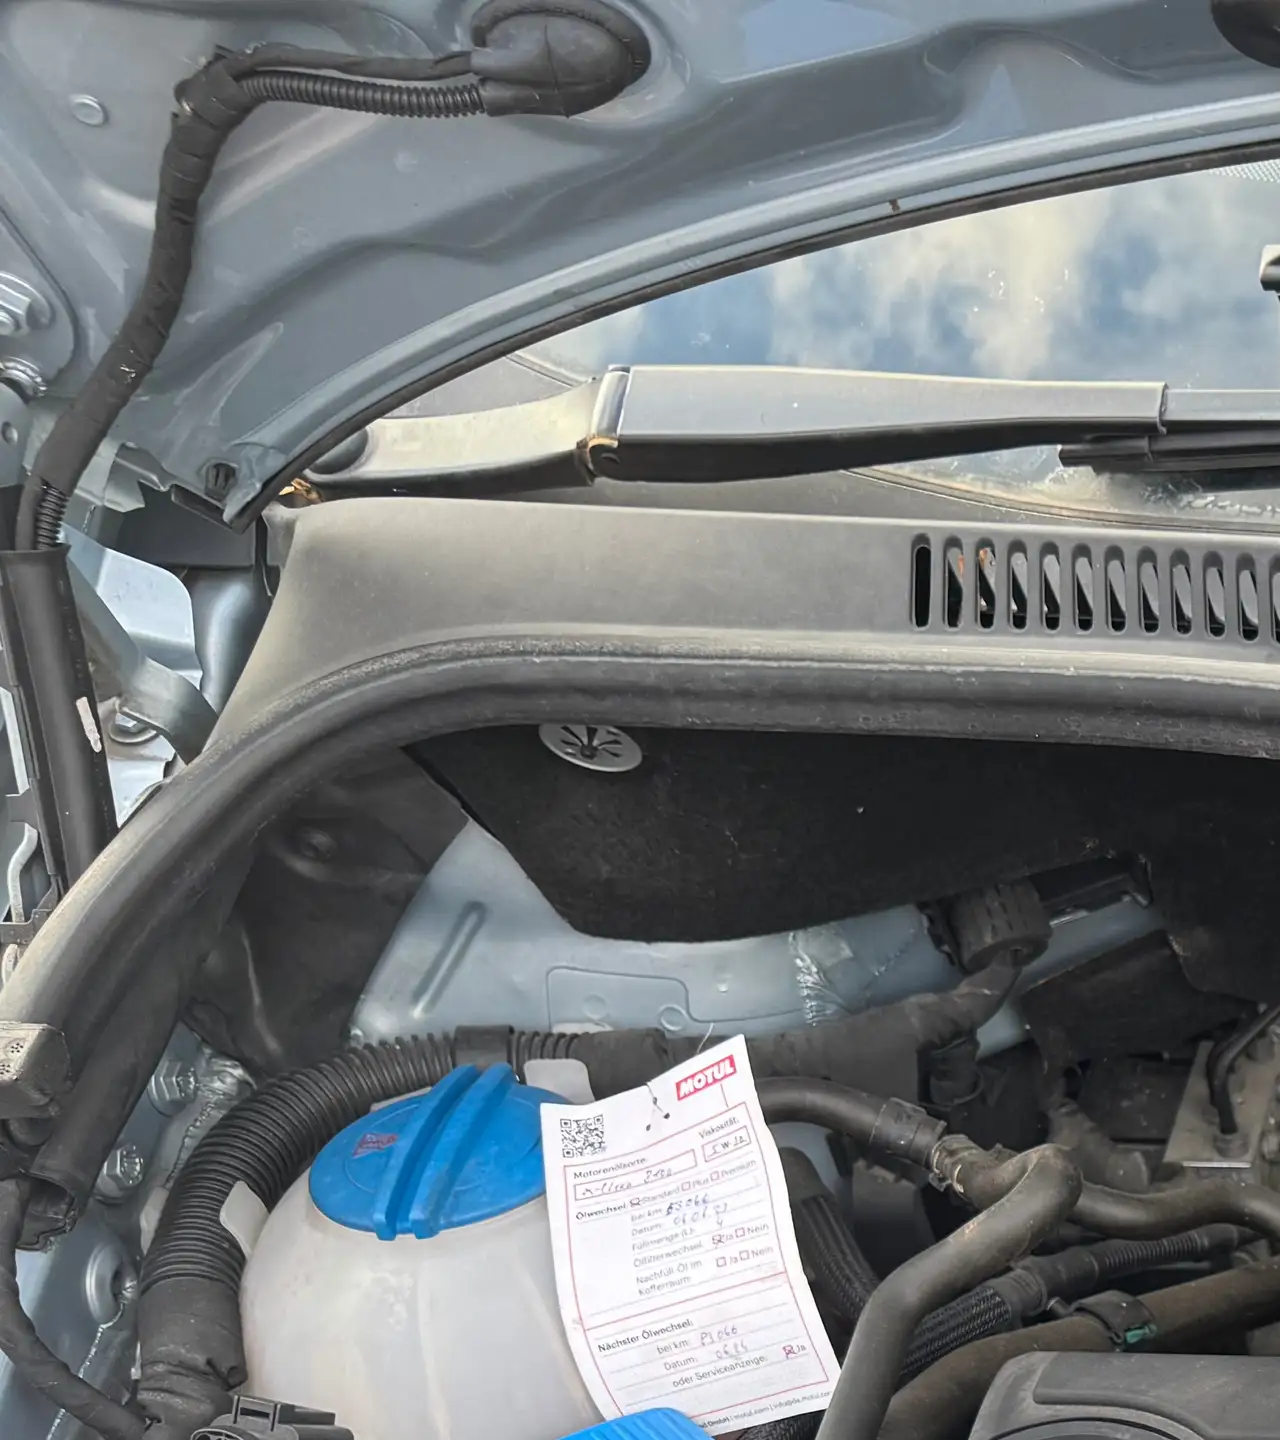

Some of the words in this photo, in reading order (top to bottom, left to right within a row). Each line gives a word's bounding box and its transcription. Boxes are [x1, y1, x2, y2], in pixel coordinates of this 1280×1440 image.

[677, 1058, 735, 1100] MOTUL
[597, 1335, 640, 1353] Nächster
[664, 1355, 698, 1372] Datum:
[672, 1375, 694, 1388] oder
